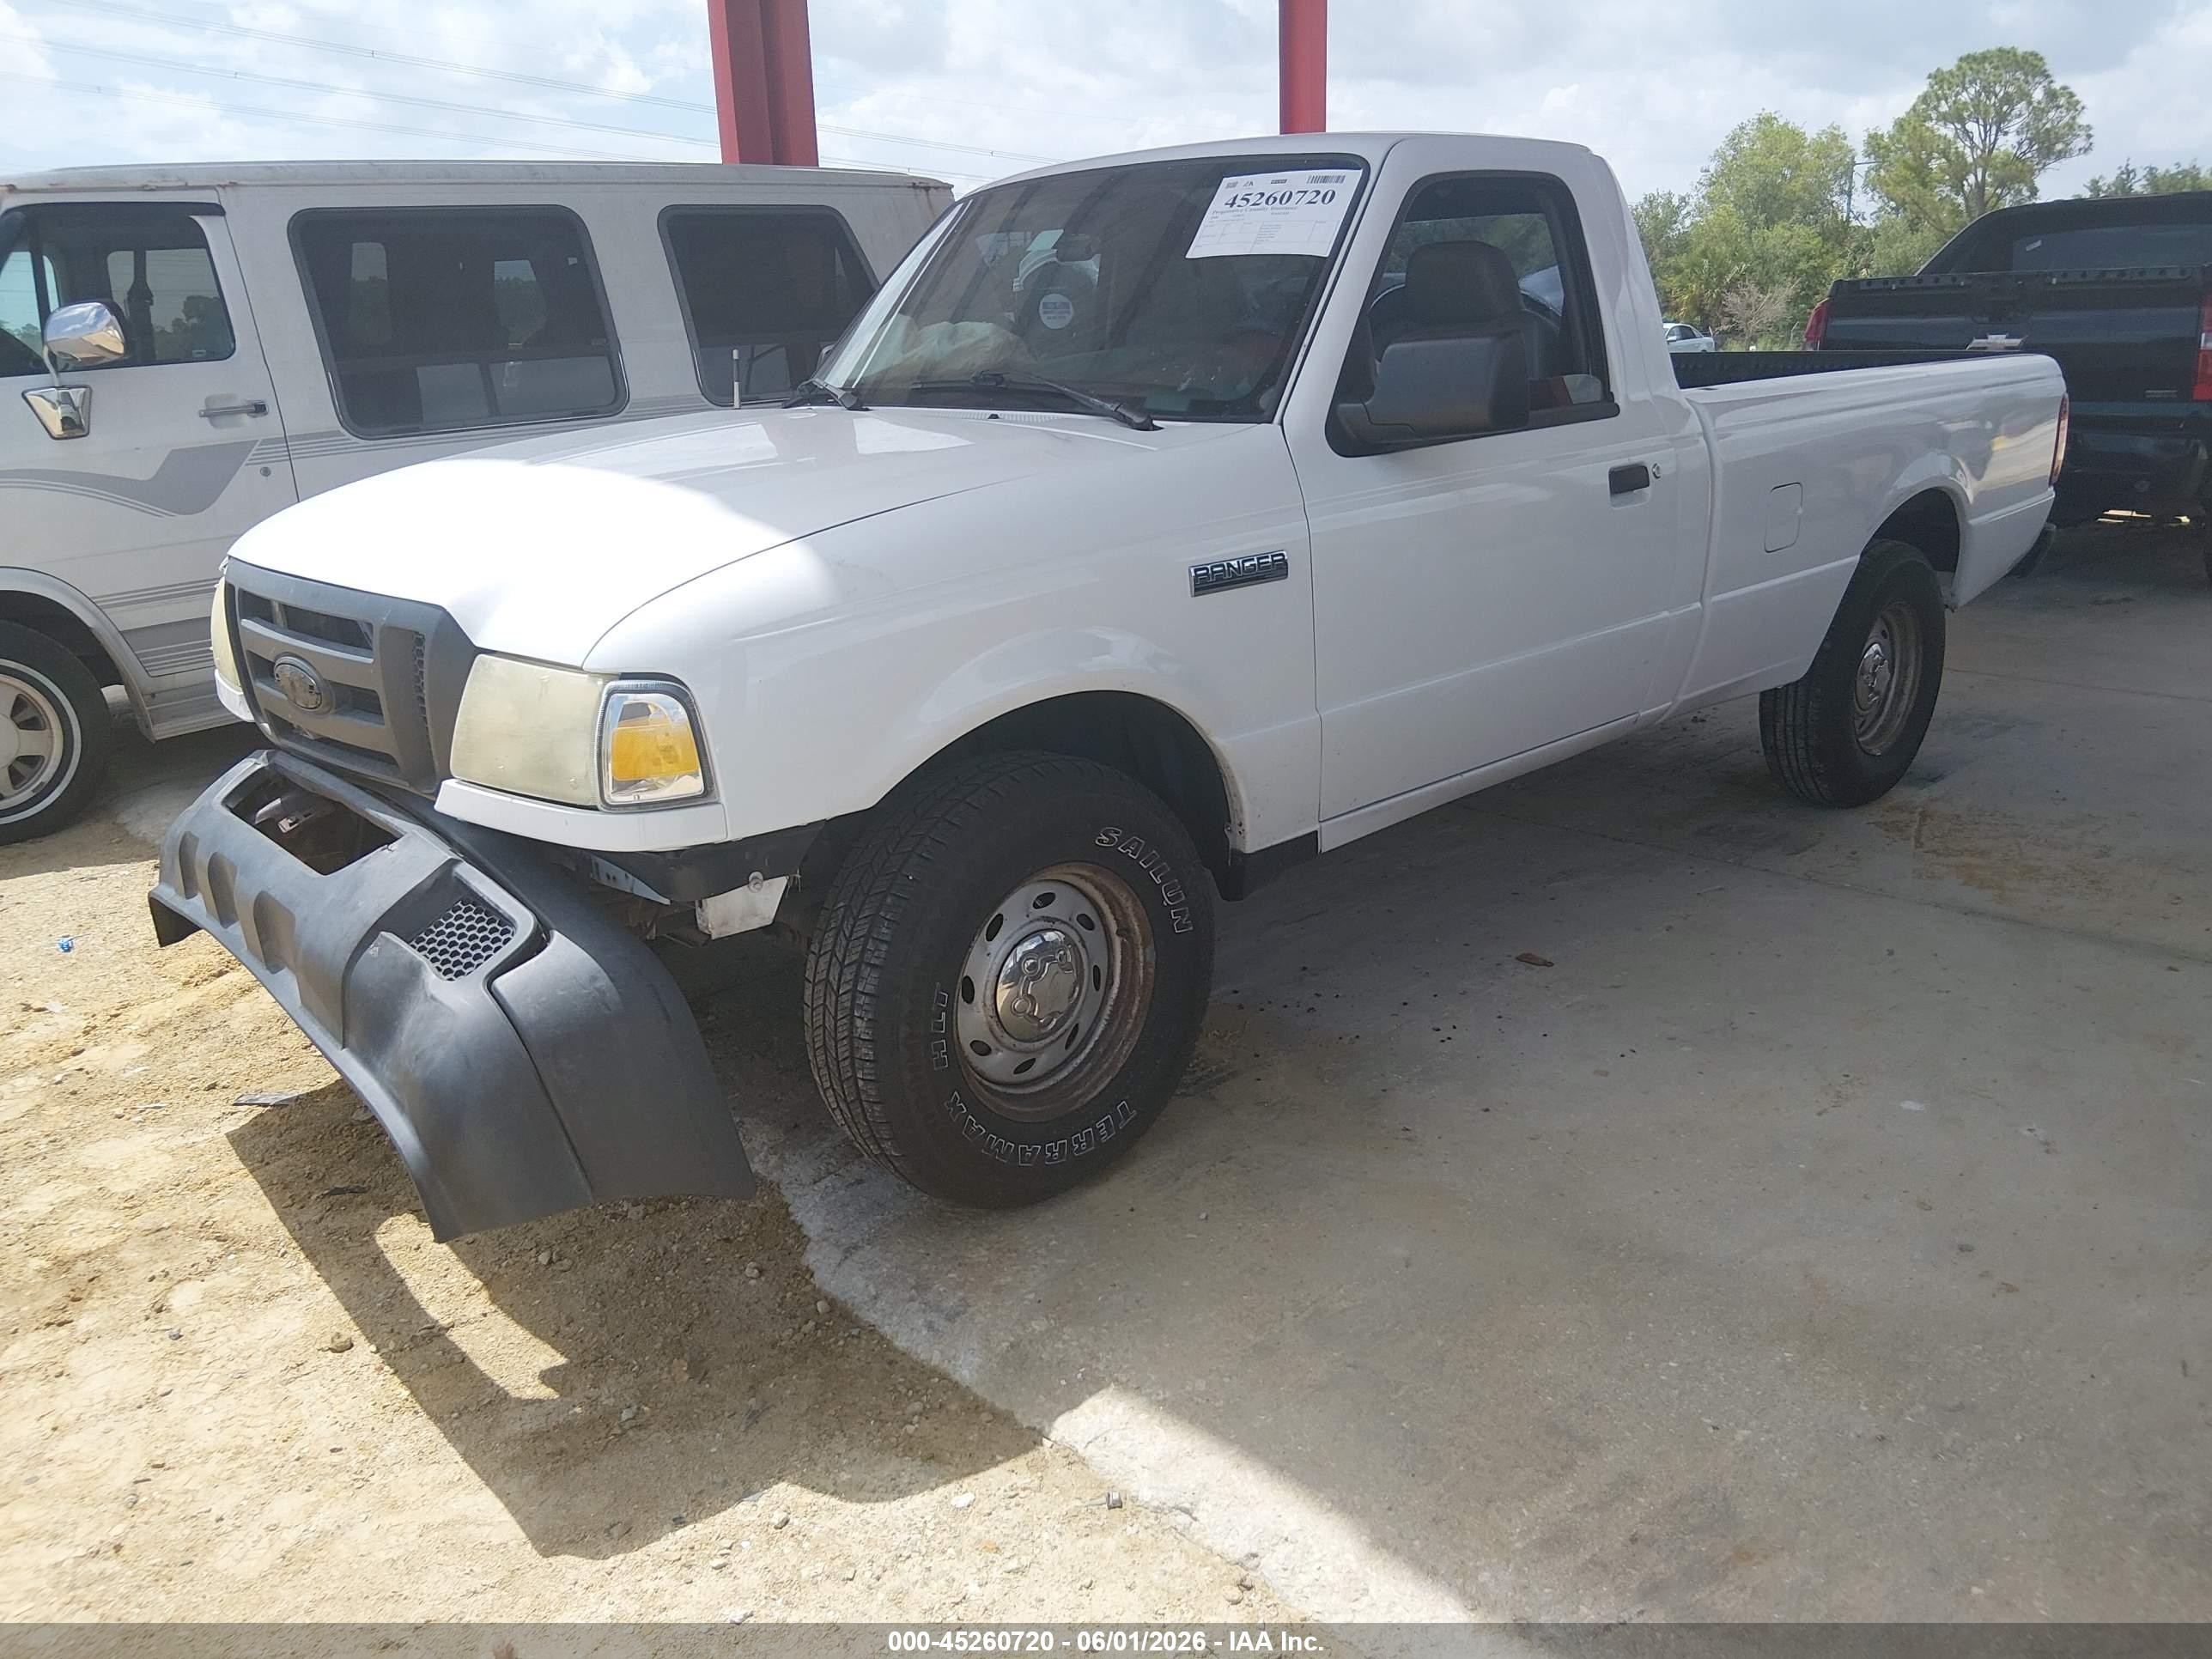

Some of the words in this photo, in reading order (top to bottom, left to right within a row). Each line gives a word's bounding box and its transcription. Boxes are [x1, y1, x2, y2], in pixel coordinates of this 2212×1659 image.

[1224, 190, 1335, 208] 45260720
[1192, 550, 1287, 585] RANGER
[1095, 827, 1193, 933] SAILUN
[944, 1091, 1137, 1167] TERRAMAX
